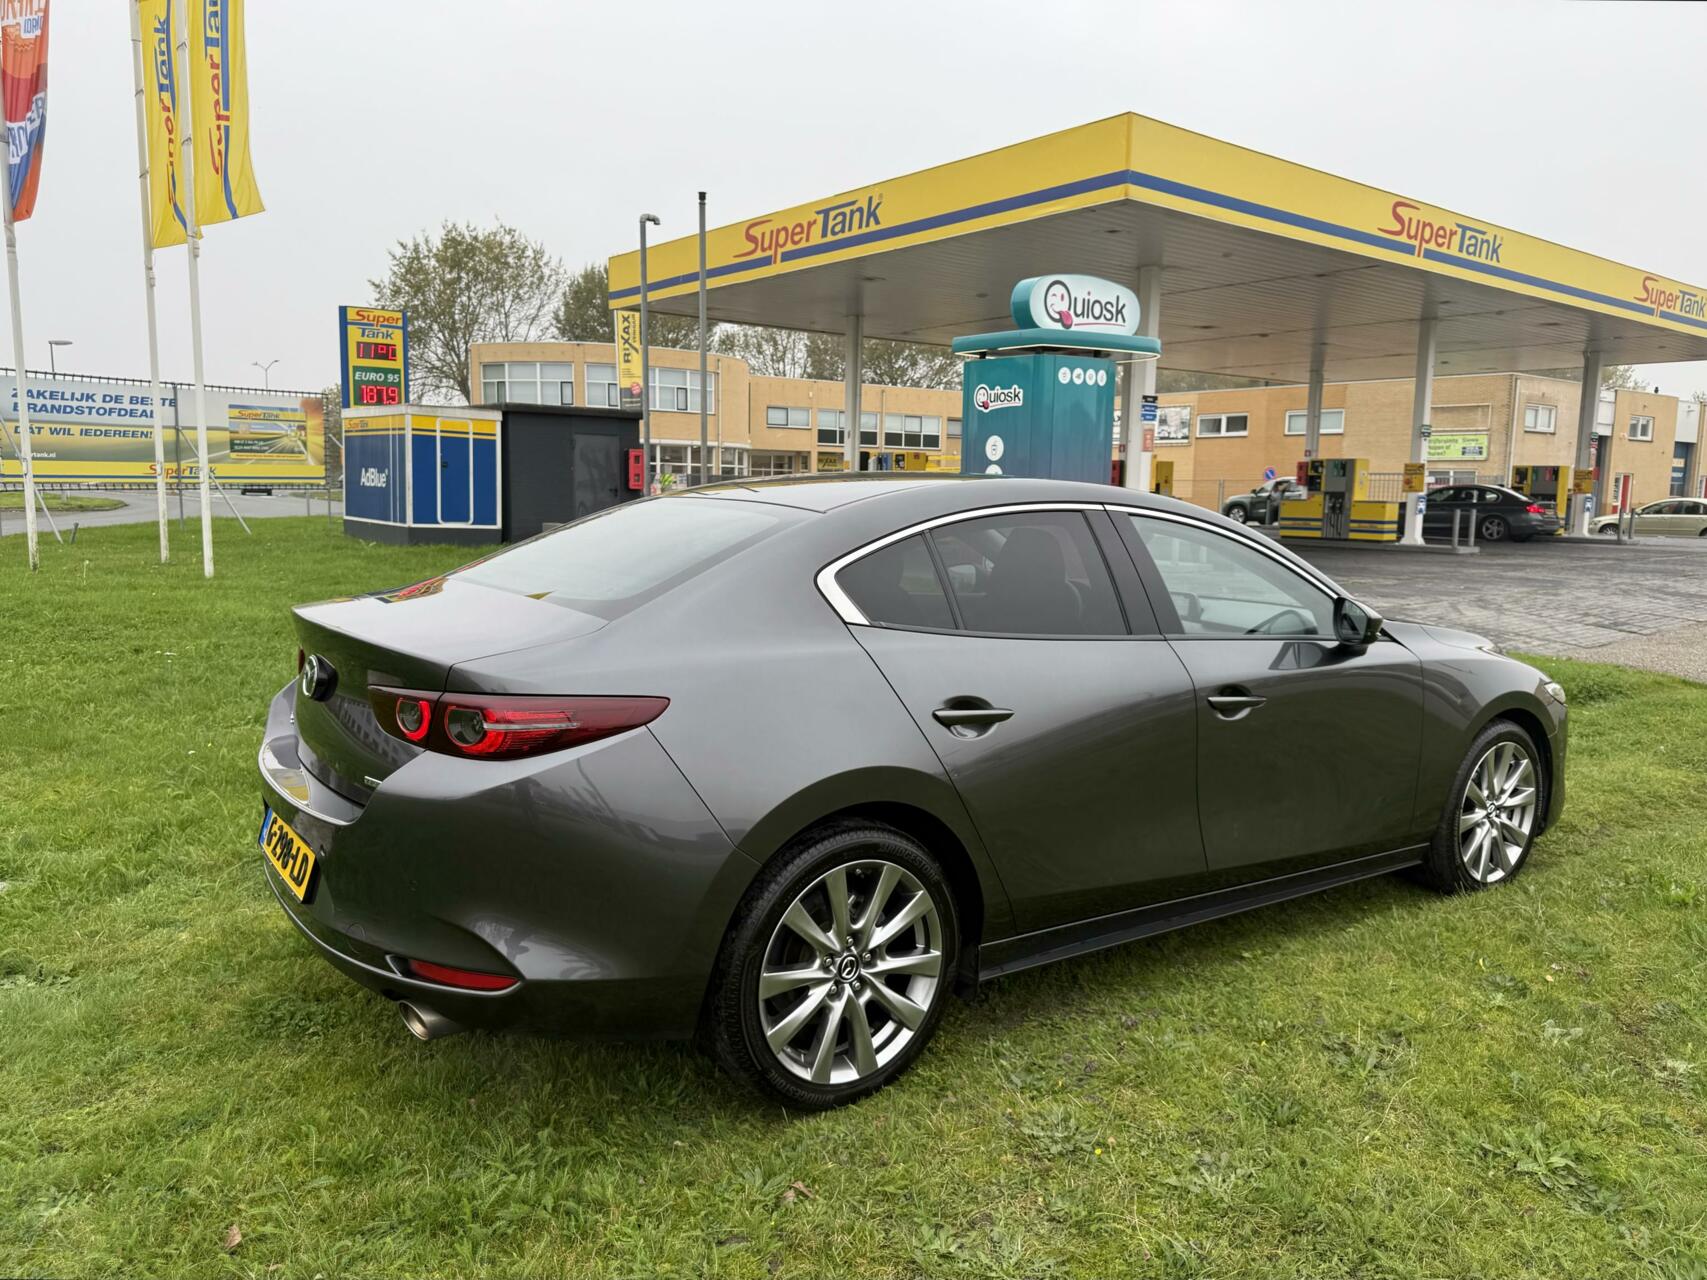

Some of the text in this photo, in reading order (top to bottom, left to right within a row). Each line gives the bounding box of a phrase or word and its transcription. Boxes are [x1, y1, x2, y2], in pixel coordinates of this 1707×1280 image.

[732, 196, 882, 264] SuperTank
[1377, 200, 1502, 263] SuperTank
[1044, 280, 1126, 329] Quiosk
[1633, 275, 1706, 318] SuperTank
[353, 310, 402, 327] Super
[357, 327, 394, 340] Tank
[621, 314, 639, 363] RIXAX
[354, 371, 400, 383] EURO 95
[102, 394, 124, 404] DE
[129, 395, 177, 408] BETE
[976, 386, 1021, 409] Quiosk
[49, 427, 75, 436] WIL
[80, 428, 152, 439] IEDEREEN!
[143, 464, 216, 478] SperTak
[360, 467, 387, 488] AdBlue
